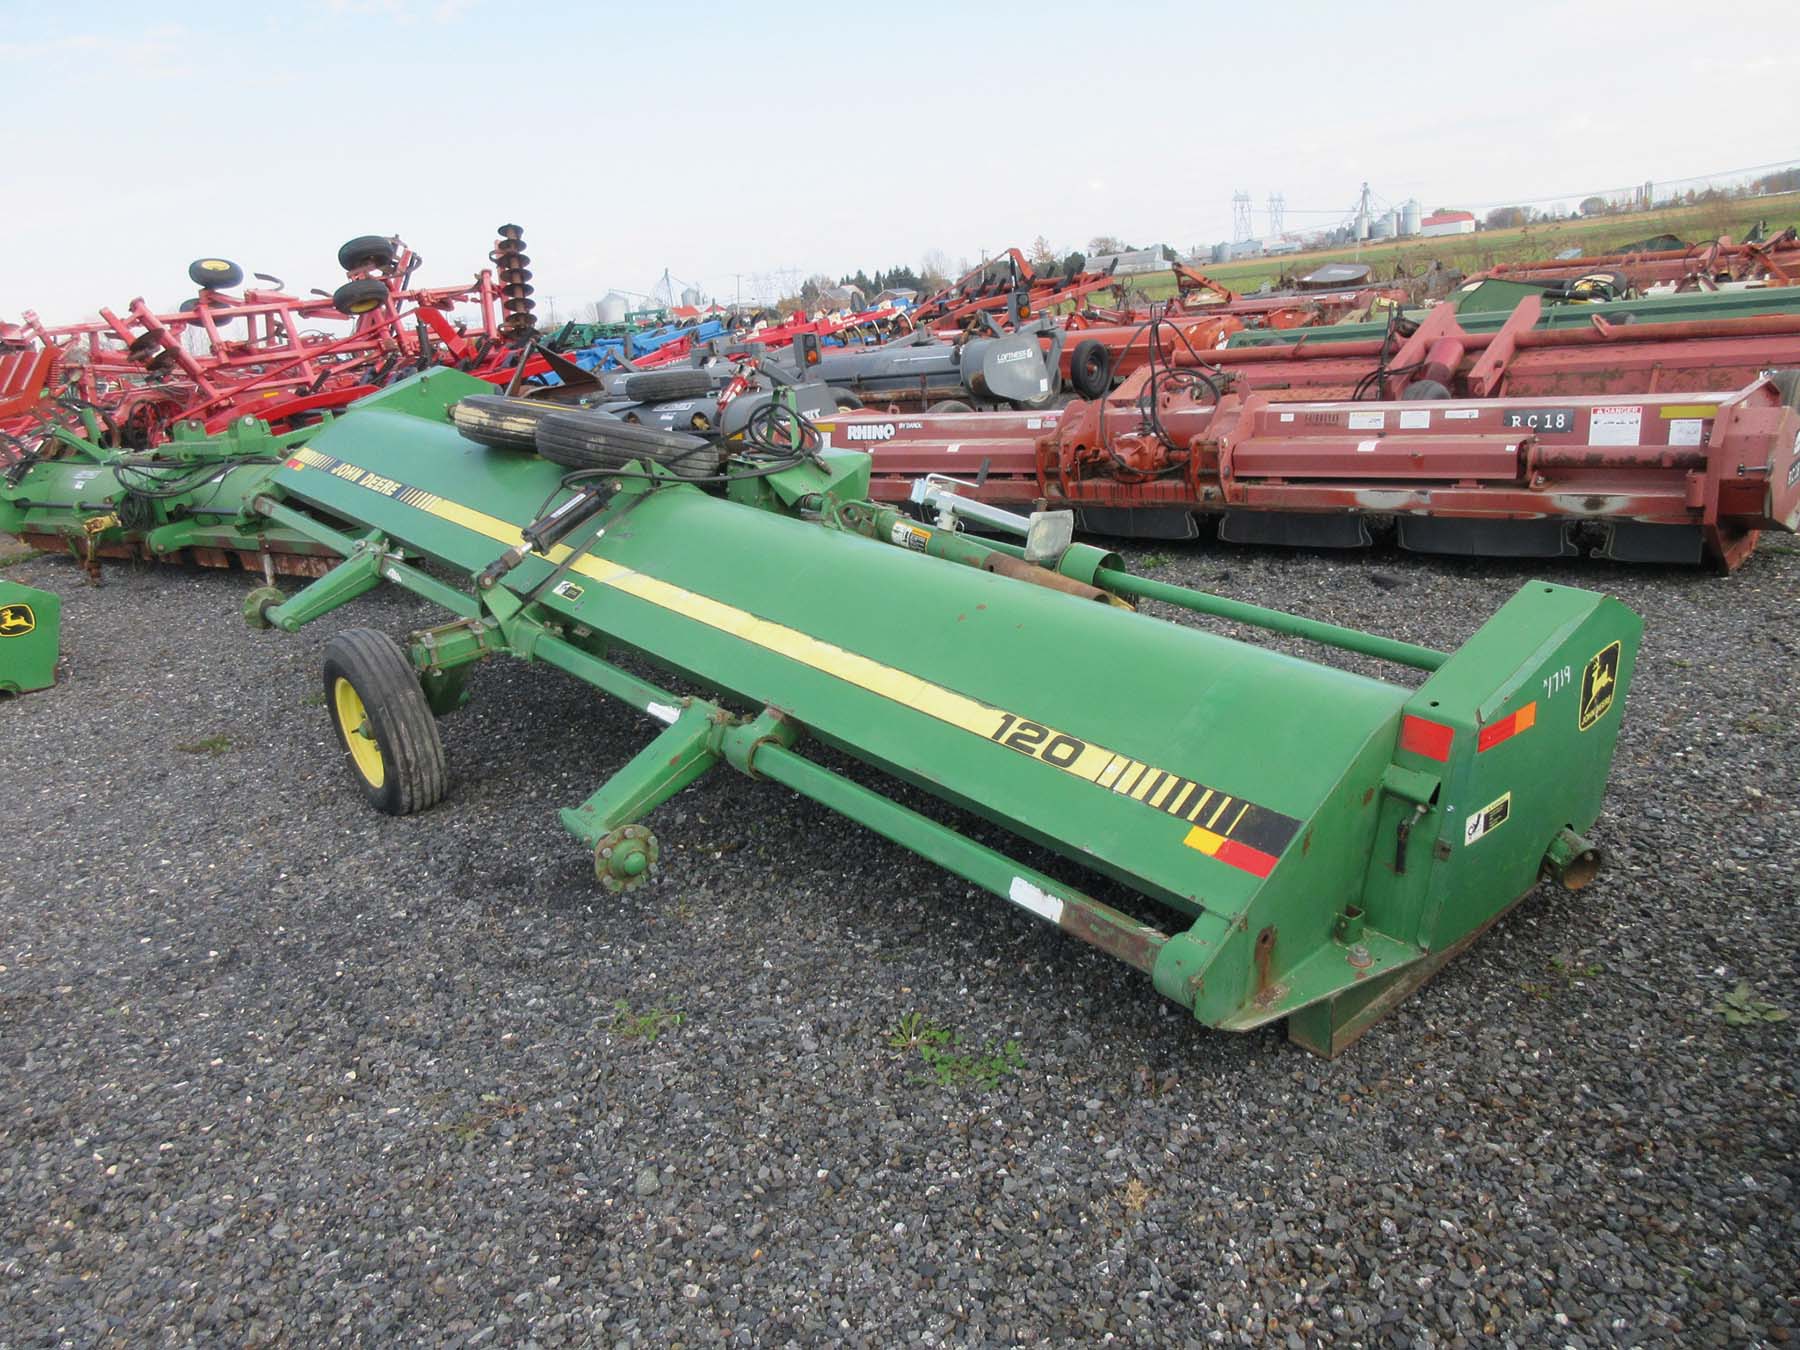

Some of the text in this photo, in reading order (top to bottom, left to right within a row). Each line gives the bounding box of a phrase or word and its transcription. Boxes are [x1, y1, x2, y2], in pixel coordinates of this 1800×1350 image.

[847, 423, 896, 440] RHINO
[330, 463, 402, 497] JOHN DEERE
[991, 713, 1086, 769] 120
